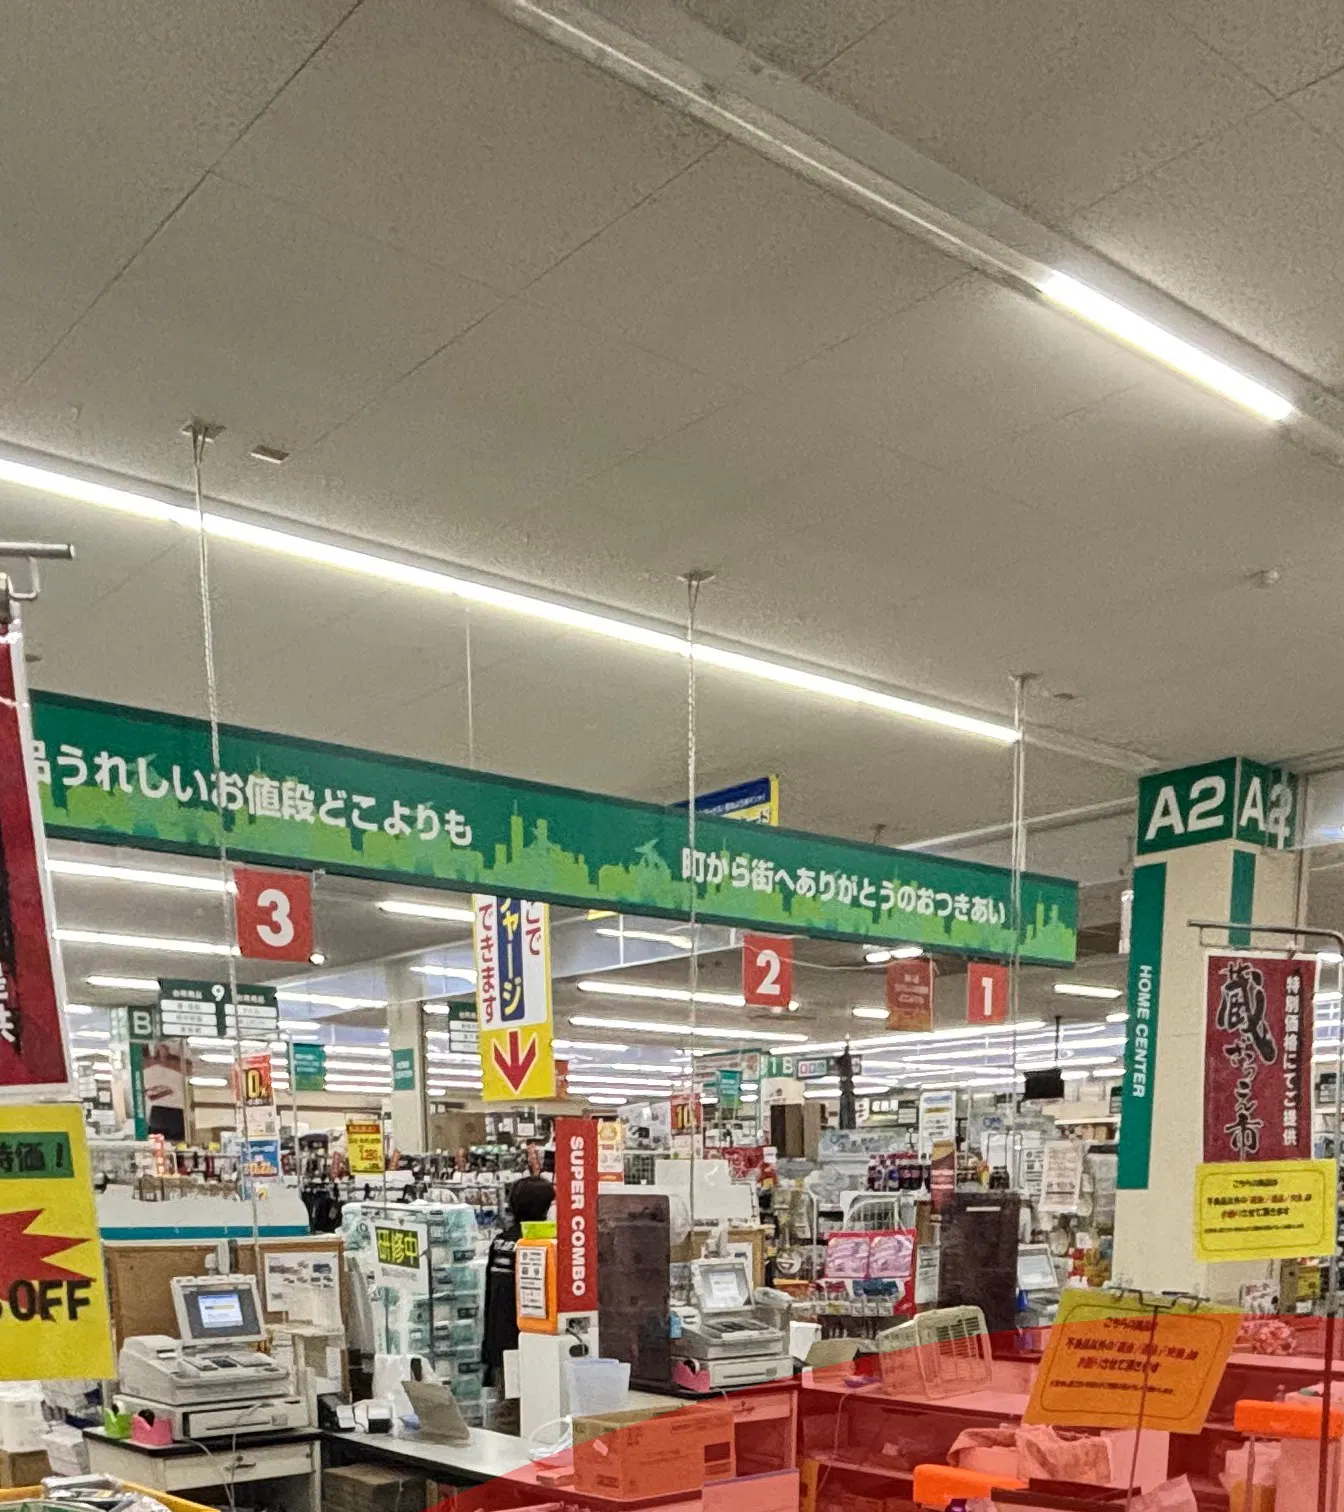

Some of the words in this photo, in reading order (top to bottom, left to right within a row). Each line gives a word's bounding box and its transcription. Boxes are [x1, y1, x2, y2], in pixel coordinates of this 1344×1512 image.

[1145, 775, 1227, 841] A2
[681, 847, 1006, 924] 町から街へありがとうのおつきあい
[256, 889, 294, 948] 3
[211, 984, 226, 1002] 9
[478, 904, 497, 1023] できます
[757, 949, 782, 995] 2
[1136, 964, 1153, 1020] HOME
[133, 1011, 152, 1035] B
[982, 976, 994, 1017] 1
[1133, 1025, 1149, 1098] CENTER
[569, 1135, 585, 1211] SUPER
[376, 1226, 421, 1268] 研修中
[571, 1216, 587, 1297] COMBO
